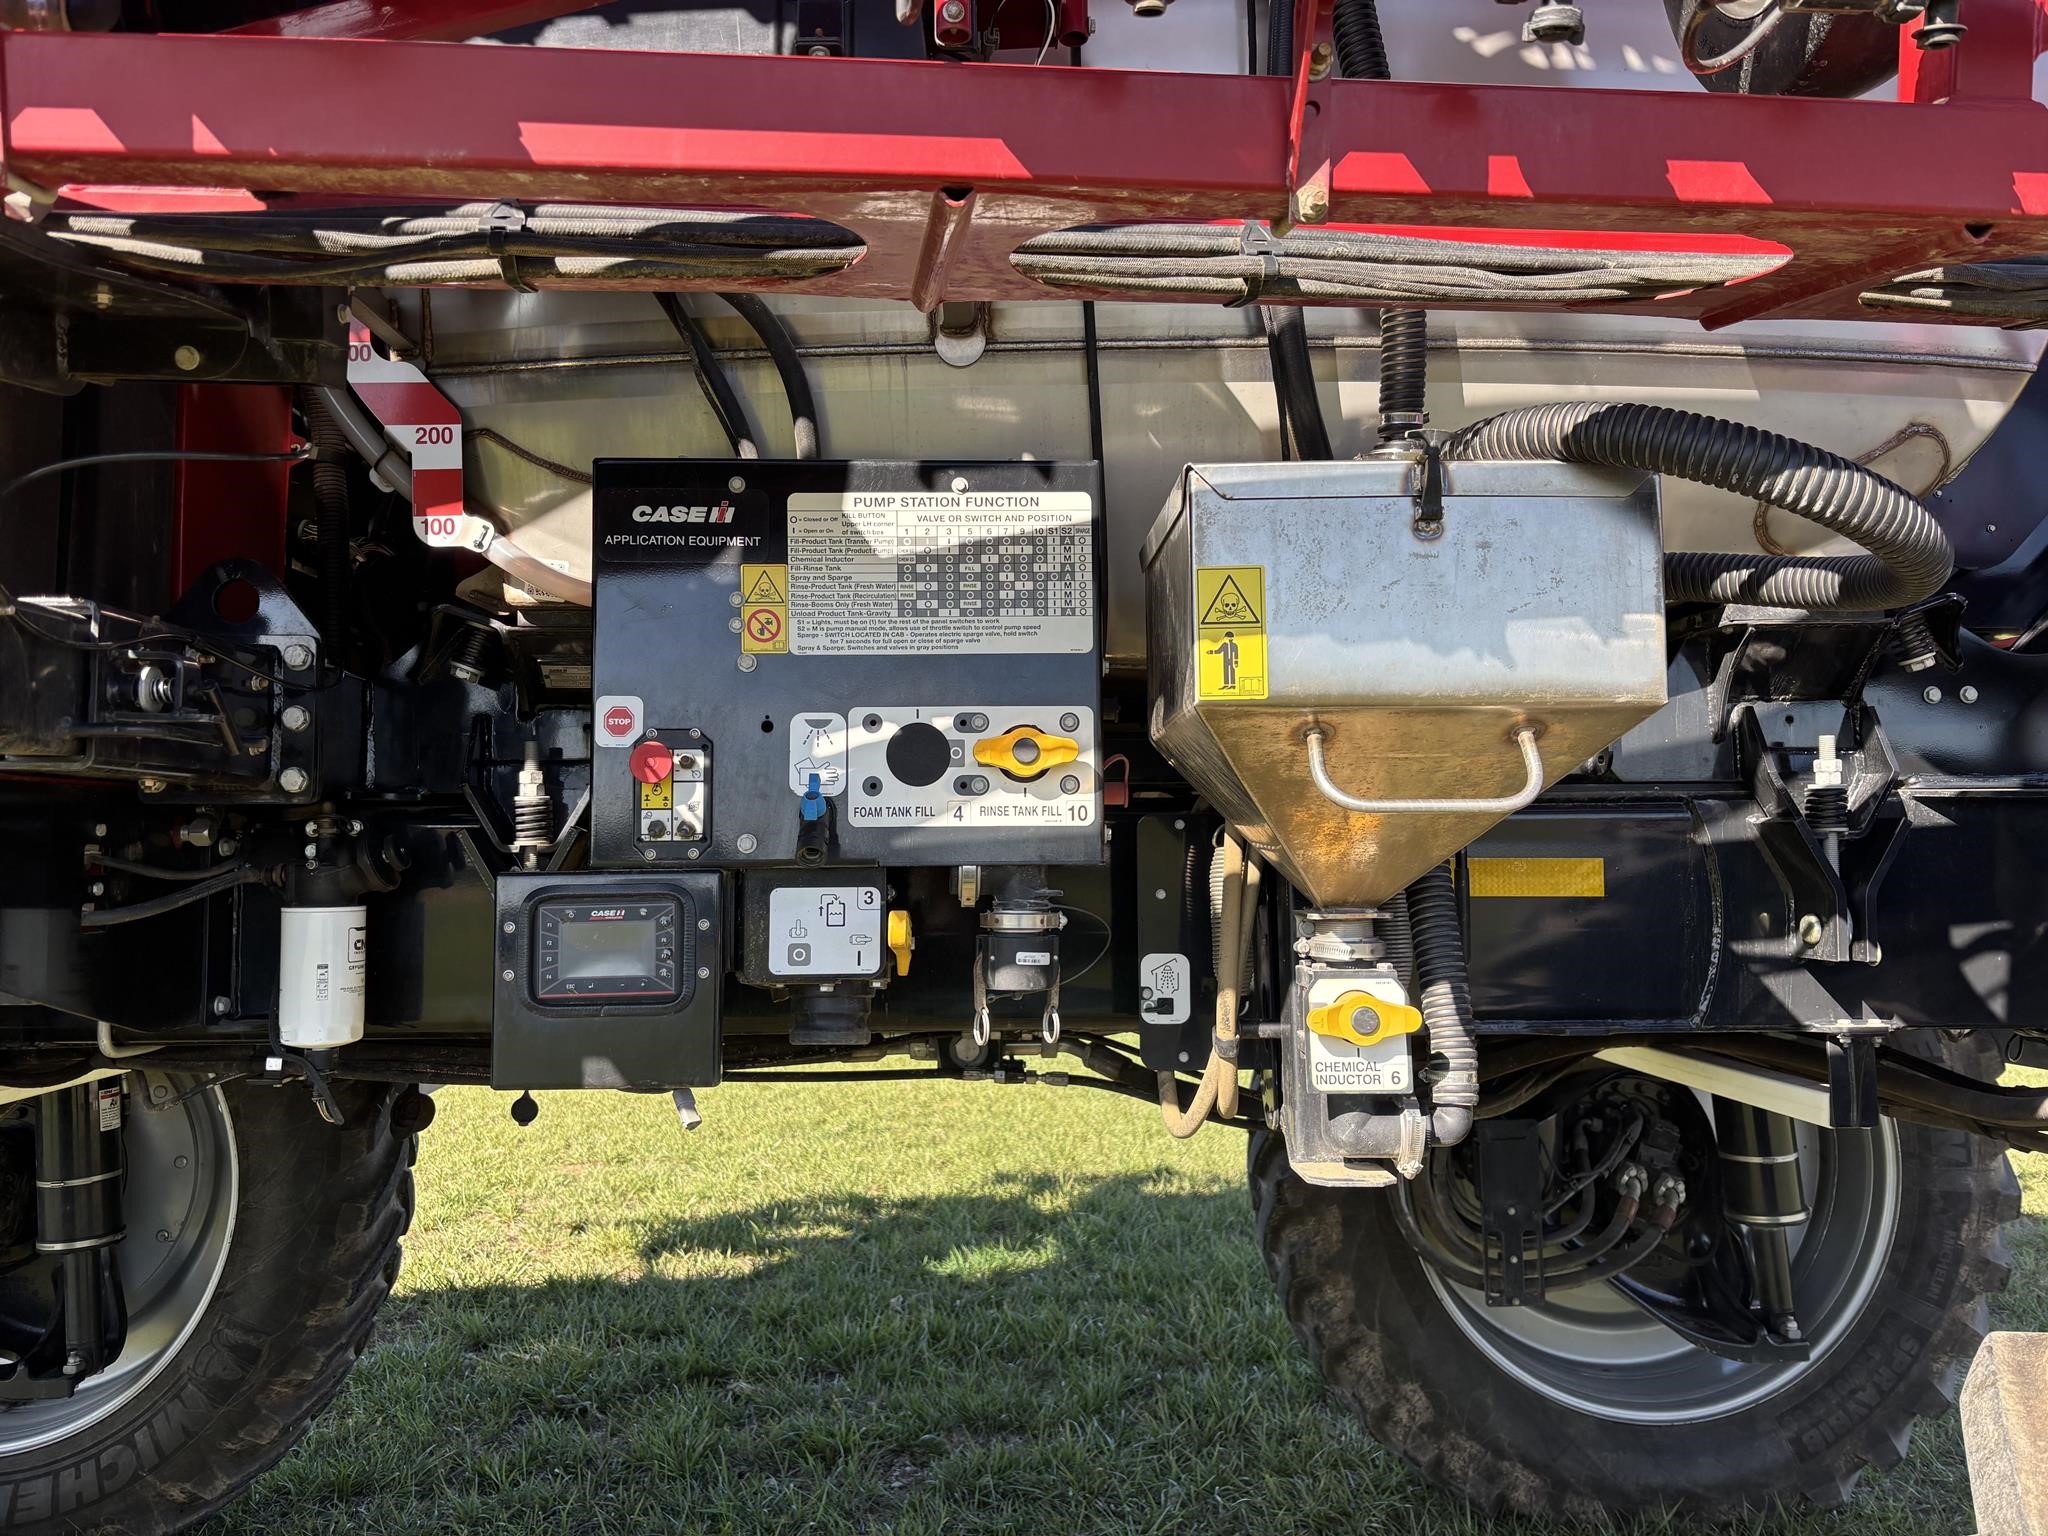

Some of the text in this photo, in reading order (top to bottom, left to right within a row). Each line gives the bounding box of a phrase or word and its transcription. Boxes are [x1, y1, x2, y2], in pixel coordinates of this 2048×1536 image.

[348, 344, 372, 362] 00
[415, 427, 454, 444] 200
[853, 497, 1039, 508] PUMP STATION FUNCTION
[632, 505, 708, 523] CASE
[421, 518, 455, 536] 100
[604, 536, 761, 546] APPLICATION EQUIPMENT
[854, 806, 936, 818] FOAM TANK FILL
[953, 806, 964, 822] 4
[980, 806, 1062, 817] RINSE TANK FILL
[1068, 805, 1088, 821] 10
[864, 891, 874, 905] 3
[1315, 1062, 1382, 1072] CHEMICAL
[1316, 1074, 1382, 1085] INDUCTOR
[1391, 1071, 1401, 1085] 6
[1927, 1230, 1958, 1301] MICHELIN
[1802, 1333, 1920, 1452] SPRAYBIB
